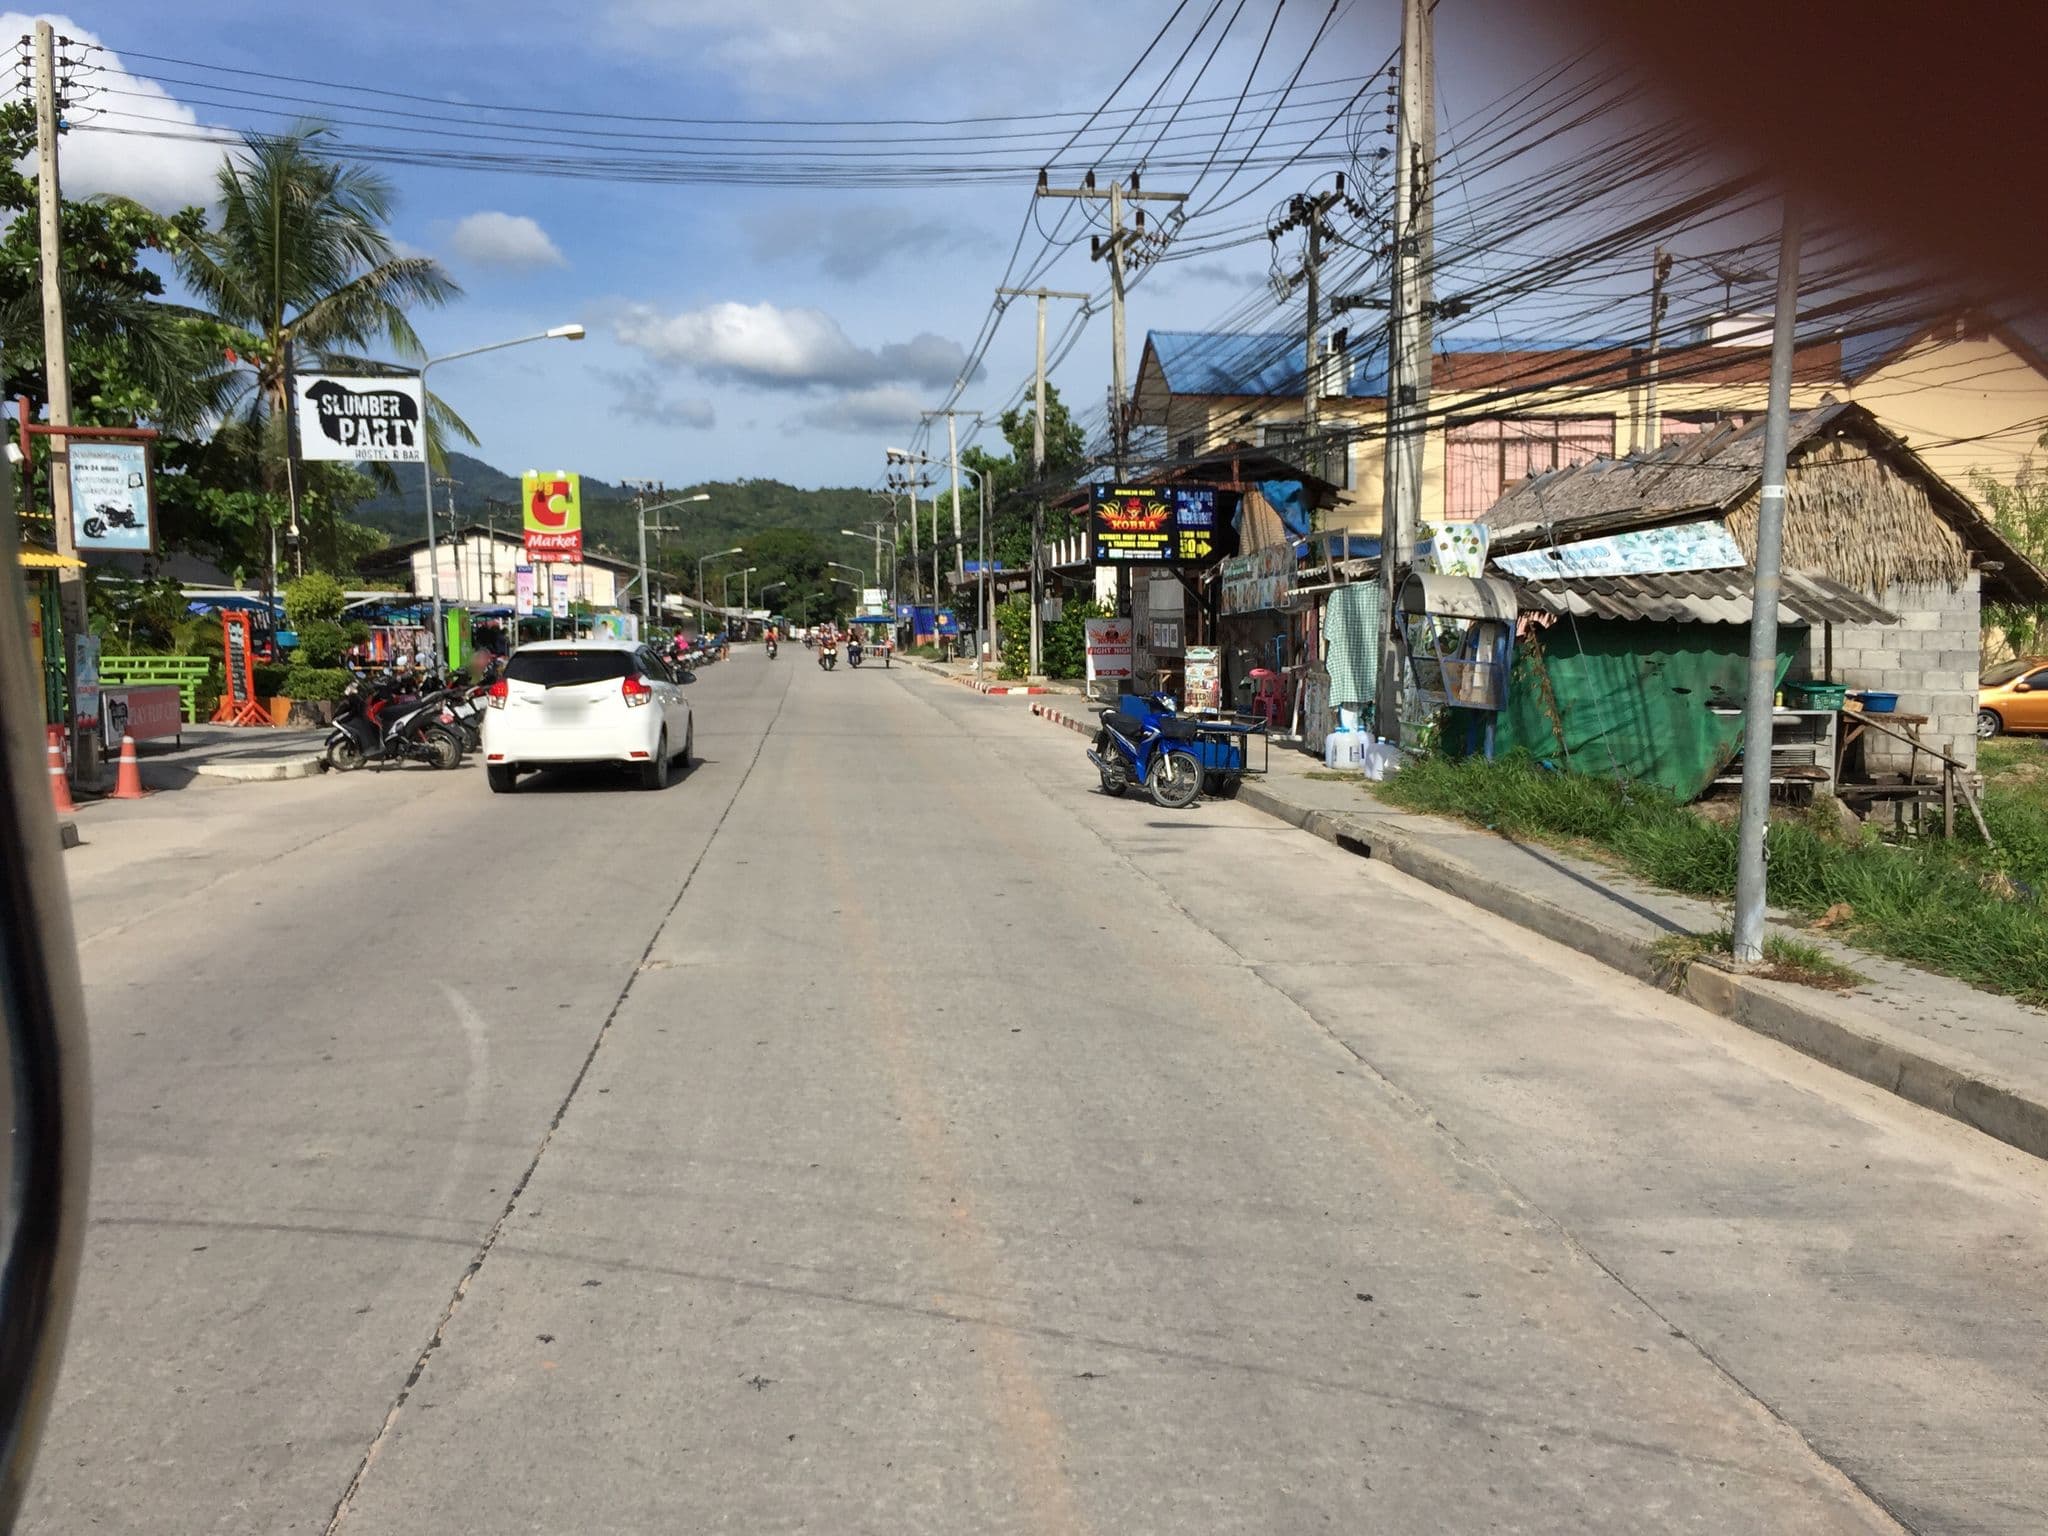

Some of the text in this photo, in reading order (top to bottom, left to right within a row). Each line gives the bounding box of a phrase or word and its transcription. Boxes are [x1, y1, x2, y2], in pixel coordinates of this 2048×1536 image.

[321, 394, 400, 417] SLUMBER
[338, 417, 419, 447] PARTY
[355, 449, 388, 459] HOSTEL
[403, 449, 419, 459] BAR
[532, 480, 574, 528] C
[1111, 520, 1158, 531] KOBRA
[528, 535, 578, 547] Market
[1179, 539, 1196, 553] 50
